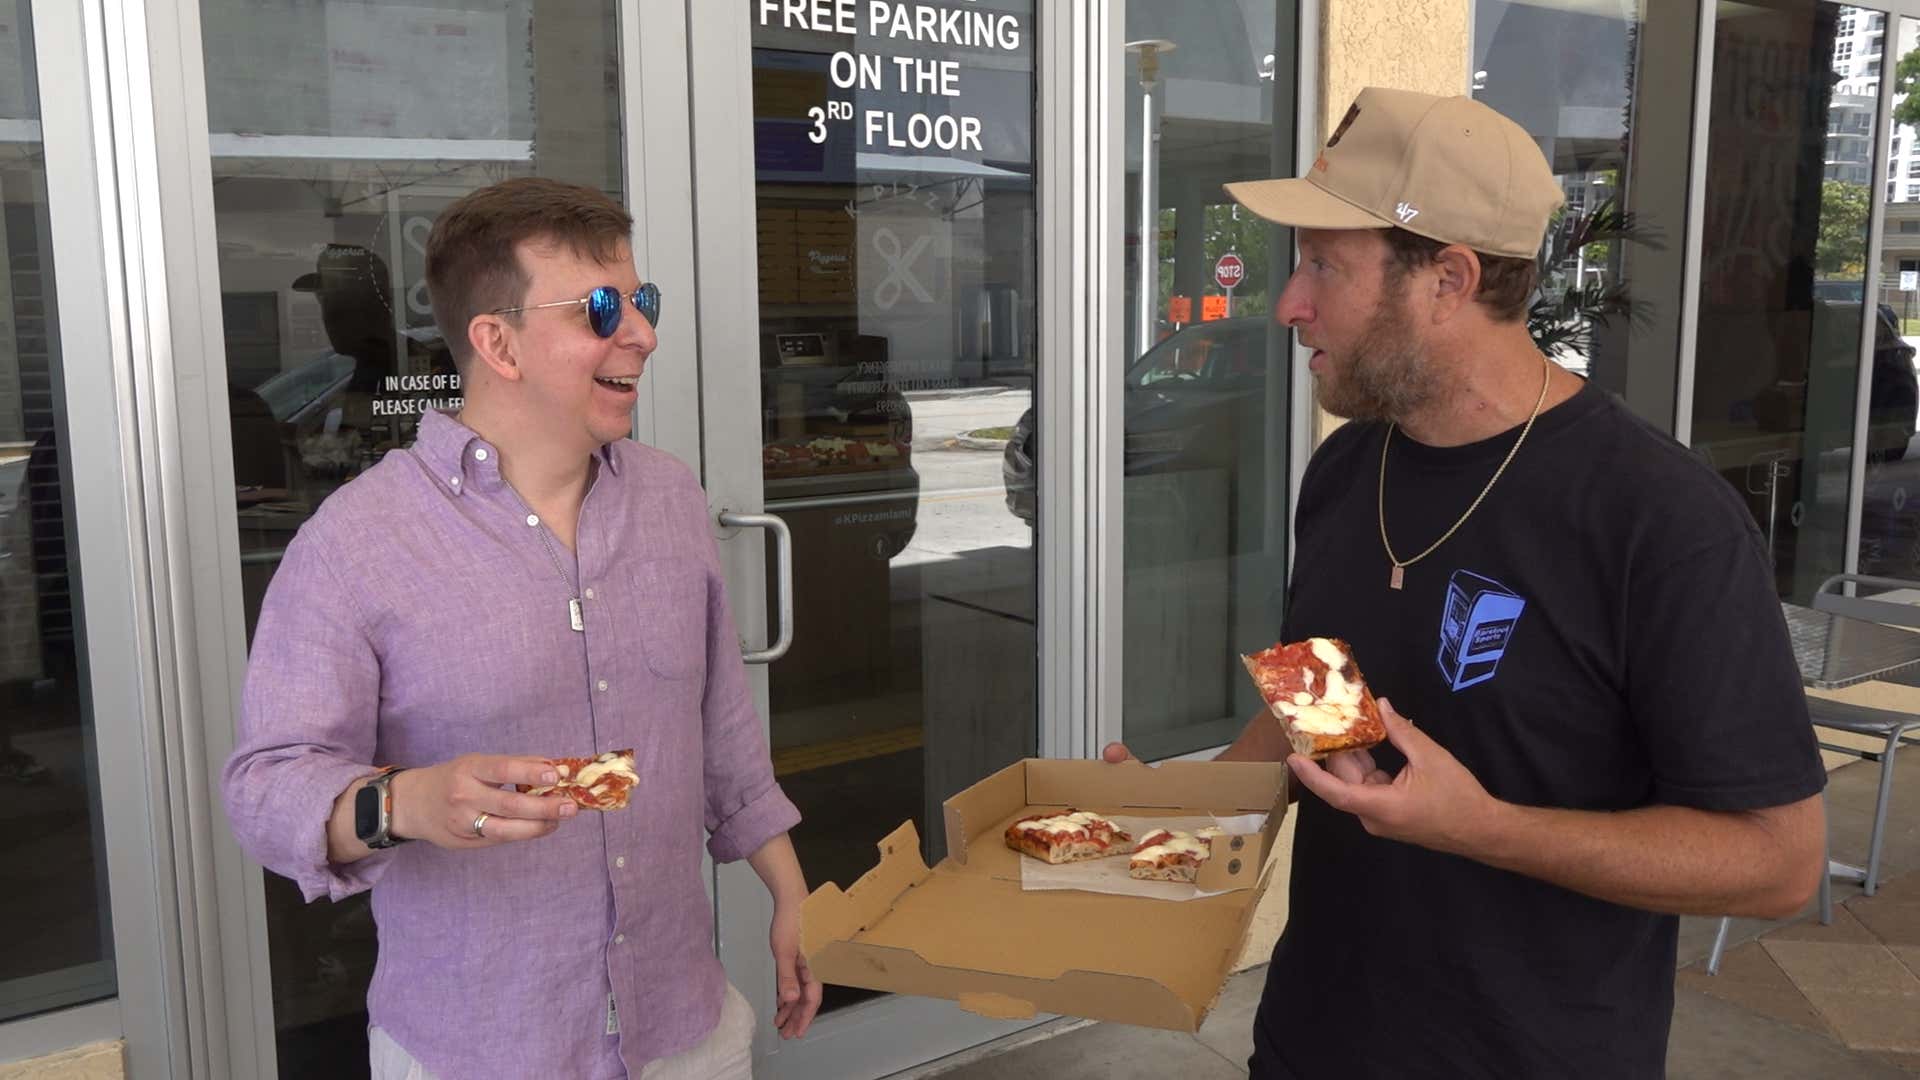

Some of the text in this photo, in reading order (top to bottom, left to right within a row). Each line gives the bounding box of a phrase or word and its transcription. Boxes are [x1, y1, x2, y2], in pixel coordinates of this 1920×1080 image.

[759, 0, 1020, 50] FREE PARKING
[830, 51, 960, 96] ON THE
[807, 101, 983, 150] 3RD FLOOR
[385, 376, 399, 391] IN
[401, 375, 430, 391] CASE
[432, 374, 447, 389] OF
[372, 399, 416, 415] PLEASE
